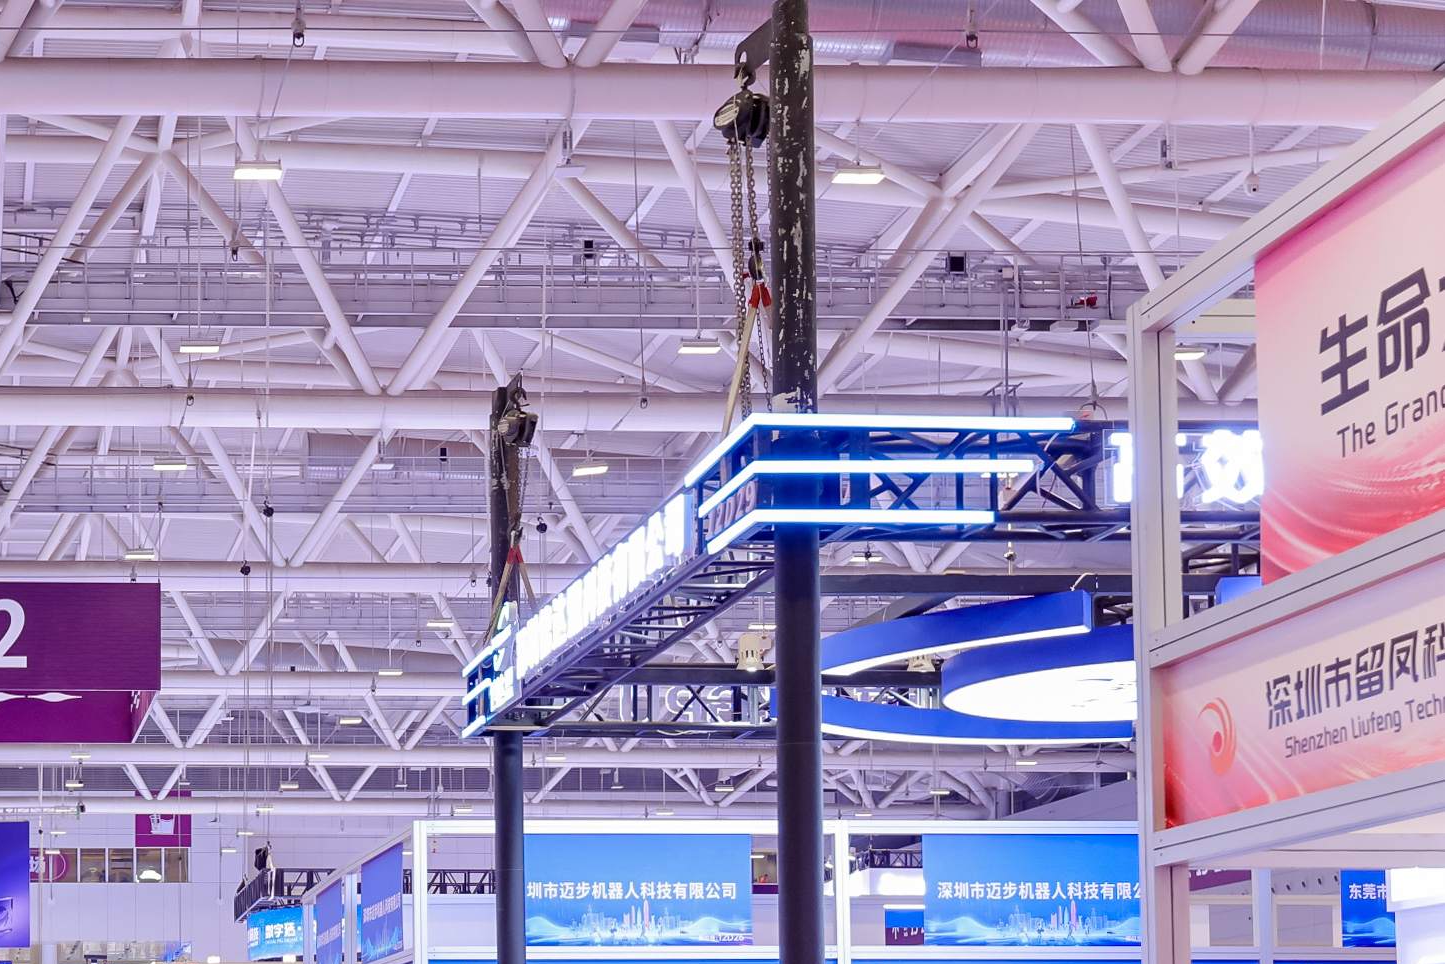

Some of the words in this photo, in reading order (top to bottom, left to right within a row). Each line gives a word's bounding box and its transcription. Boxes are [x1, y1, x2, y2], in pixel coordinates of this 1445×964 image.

[1319, 267, 1445, 416] 生命
[1337, 421, 1376, 458] The
[1285, 725, 1348, 758] Shenzhen
[1351, 708, 1402, 740] Liufeng
[1405, 694, 1445, 723] Tech
[526, 881, 737, 900] 圳市迈步机器人科技有限公司
[1348, 883, 1388, 900] 东莞市
[698, 934, 745, 942] :12D26
